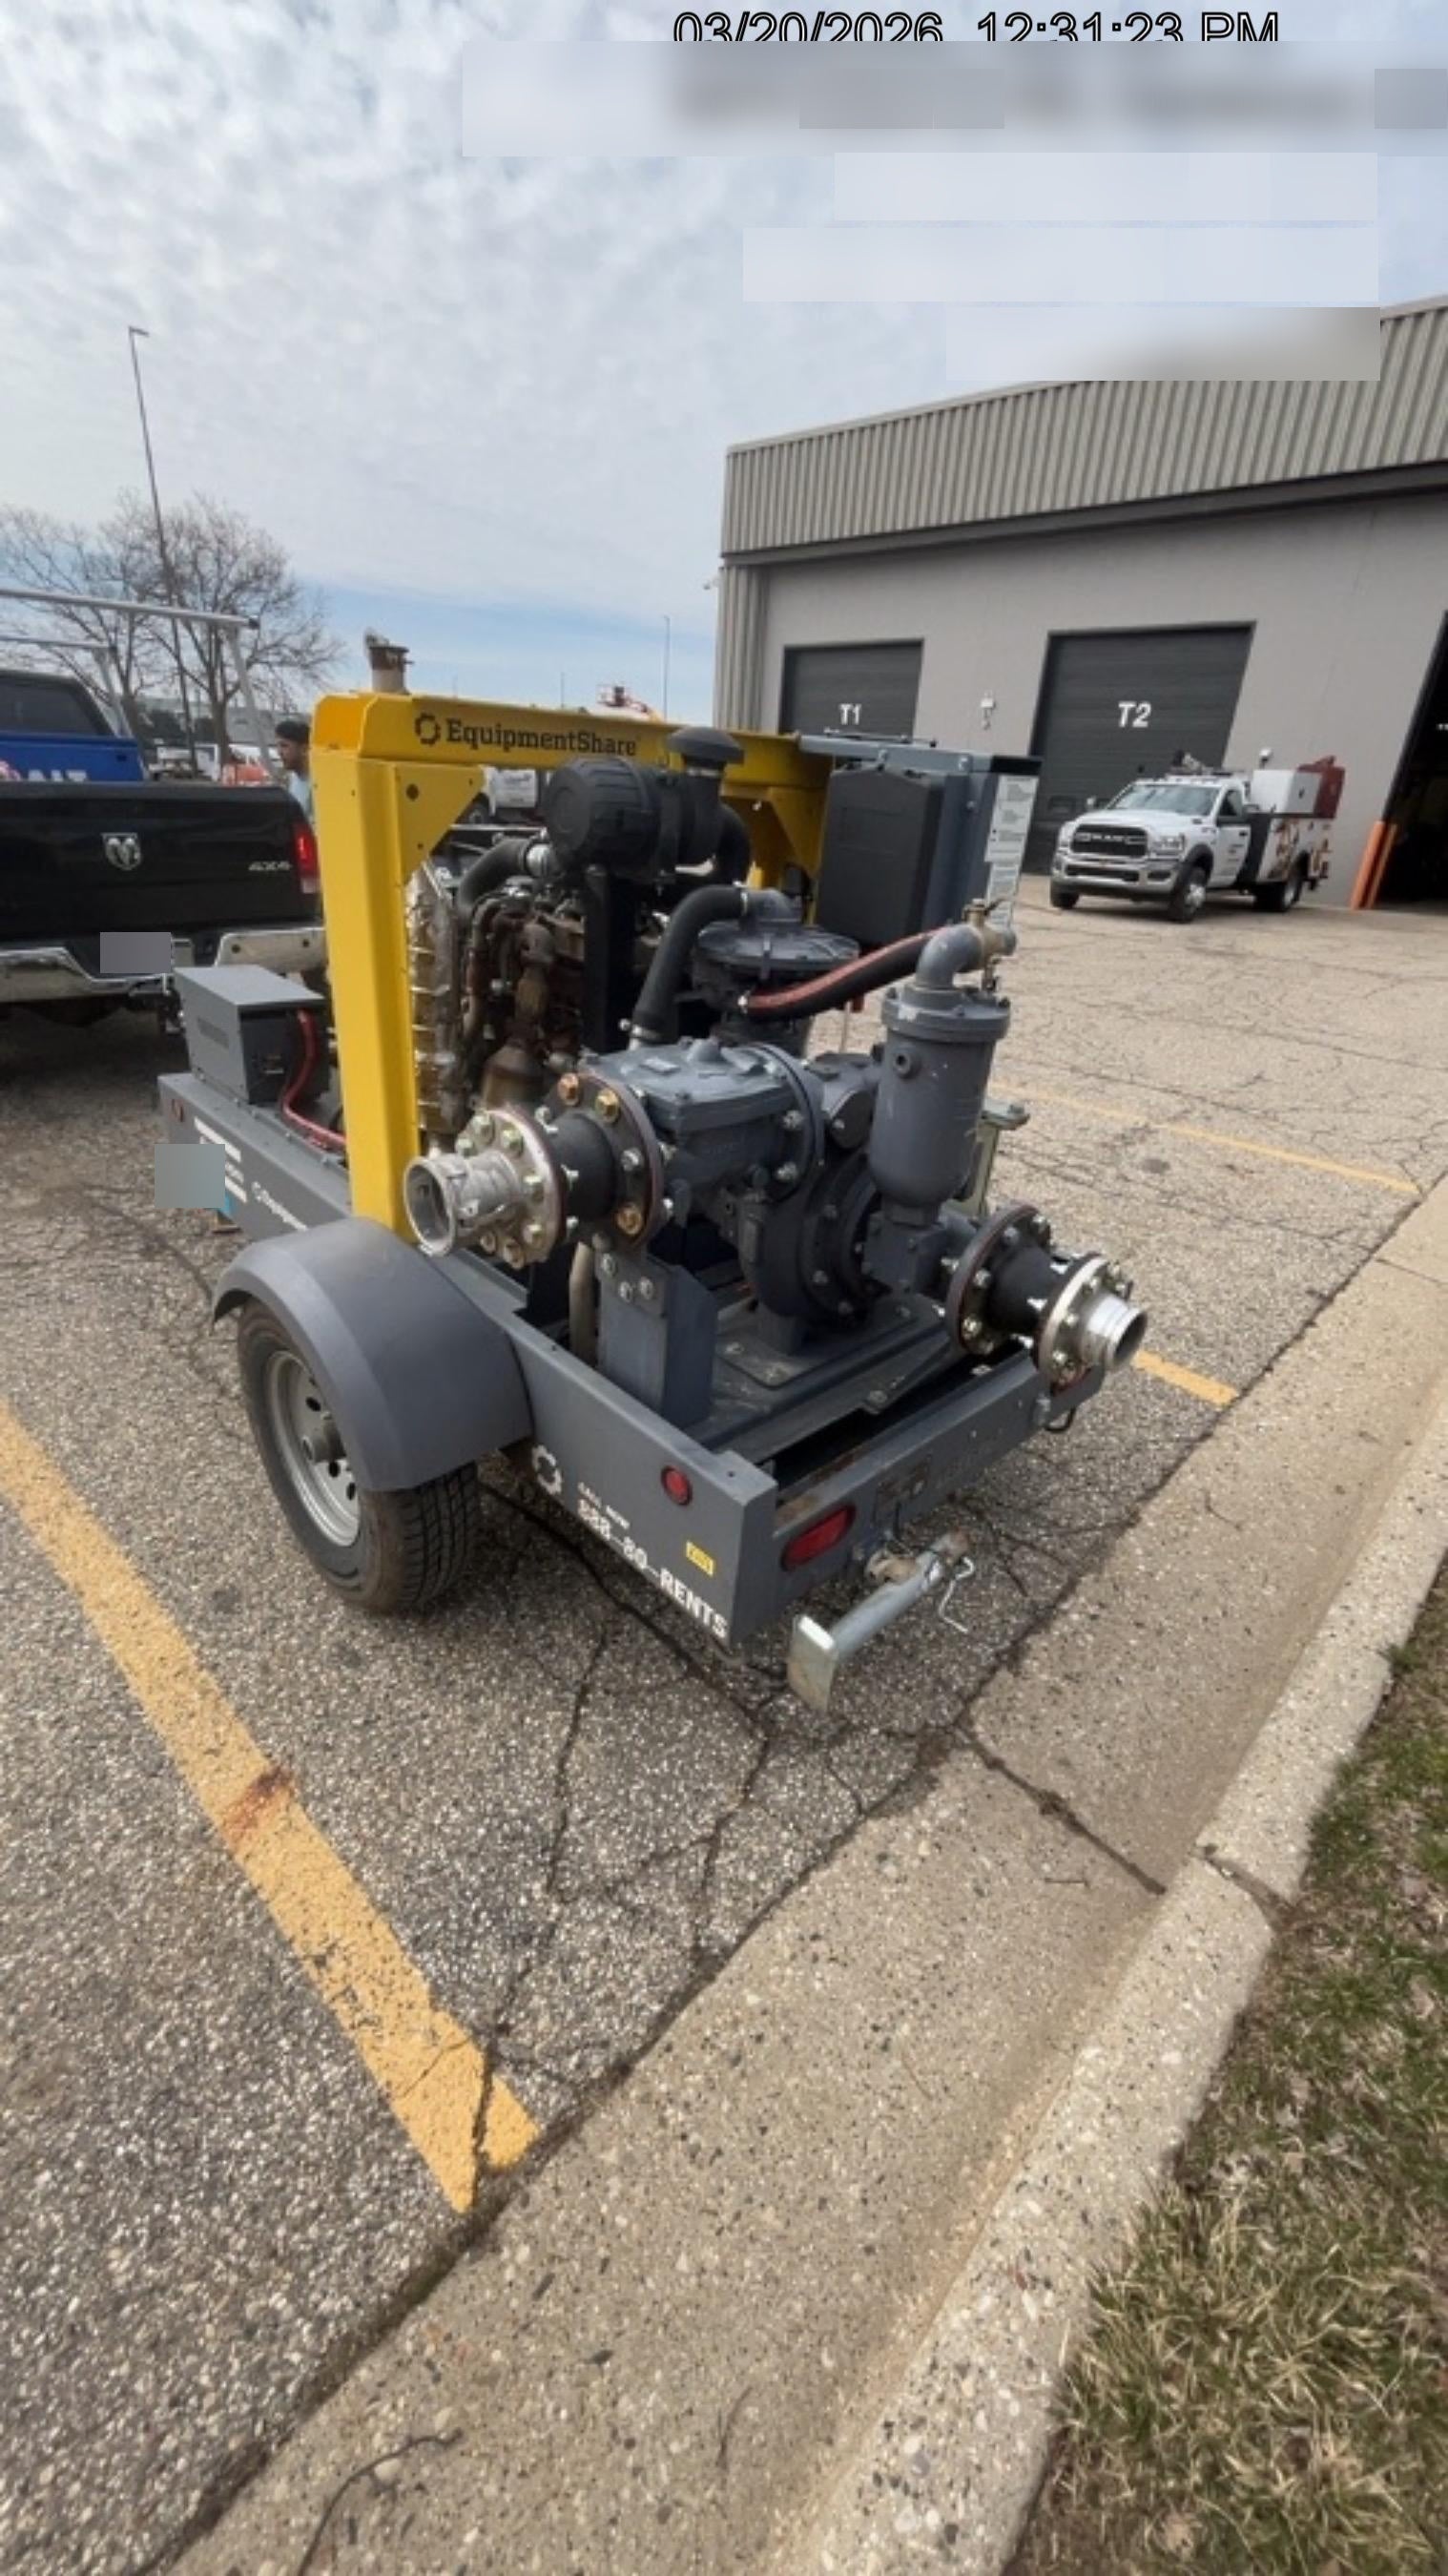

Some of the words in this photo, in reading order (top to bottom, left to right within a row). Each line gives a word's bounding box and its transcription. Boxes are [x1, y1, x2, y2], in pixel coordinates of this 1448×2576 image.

[839, 704, 861, 724] T1
[1119, 701, 1151, 727] T2
[445, 718, 636, 756] EquipmentShare
